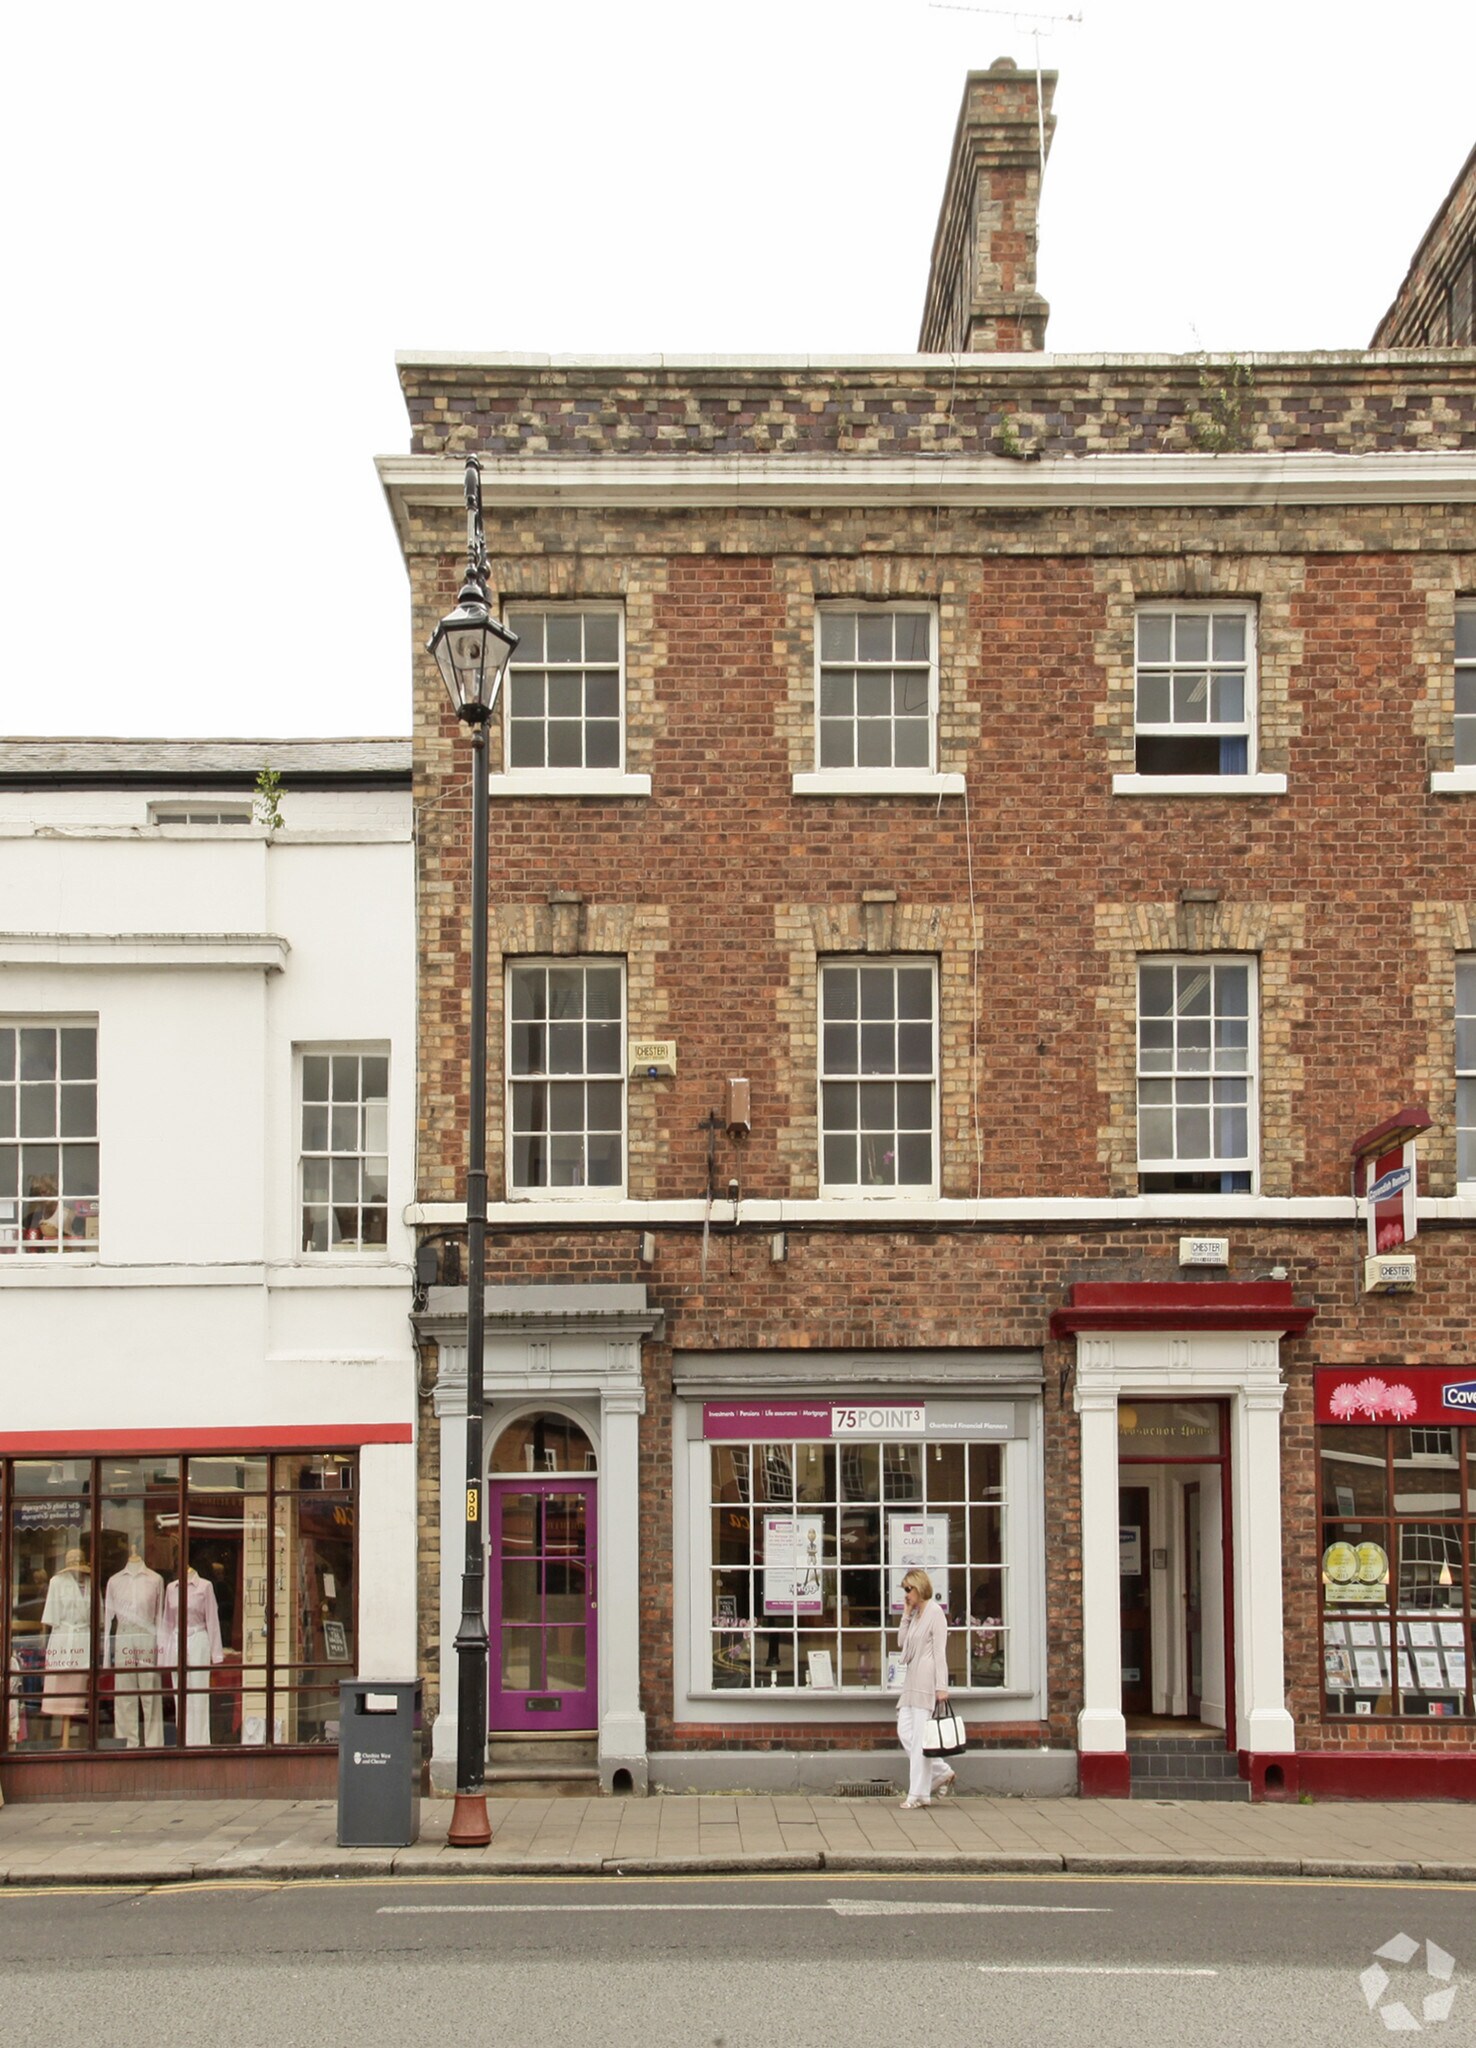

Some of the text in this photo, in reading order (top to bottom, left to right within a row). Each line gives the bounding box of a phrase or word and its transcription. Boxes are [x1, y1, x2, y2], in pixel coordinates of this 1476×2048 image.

[637, 1046, 666, 1057] CHESTER
[1369, 1180, 1391, 1200] Cavendish
[1192, 1243, 1221, 1253] CHESTER
[1381, 1266, 1411, 1276] CHESTER
[765, 1409, 774, 1417] Life
[803, 1409, 828, 1418] Mortgages
[929, 1421, 958, 1430] Chartered
[958, 1422, 983, 1430] Financial
[61, 1647, 67, 1655] is
[70, 1647, 84, 1655] run
[121, 1646, 164, 1656] Come and
